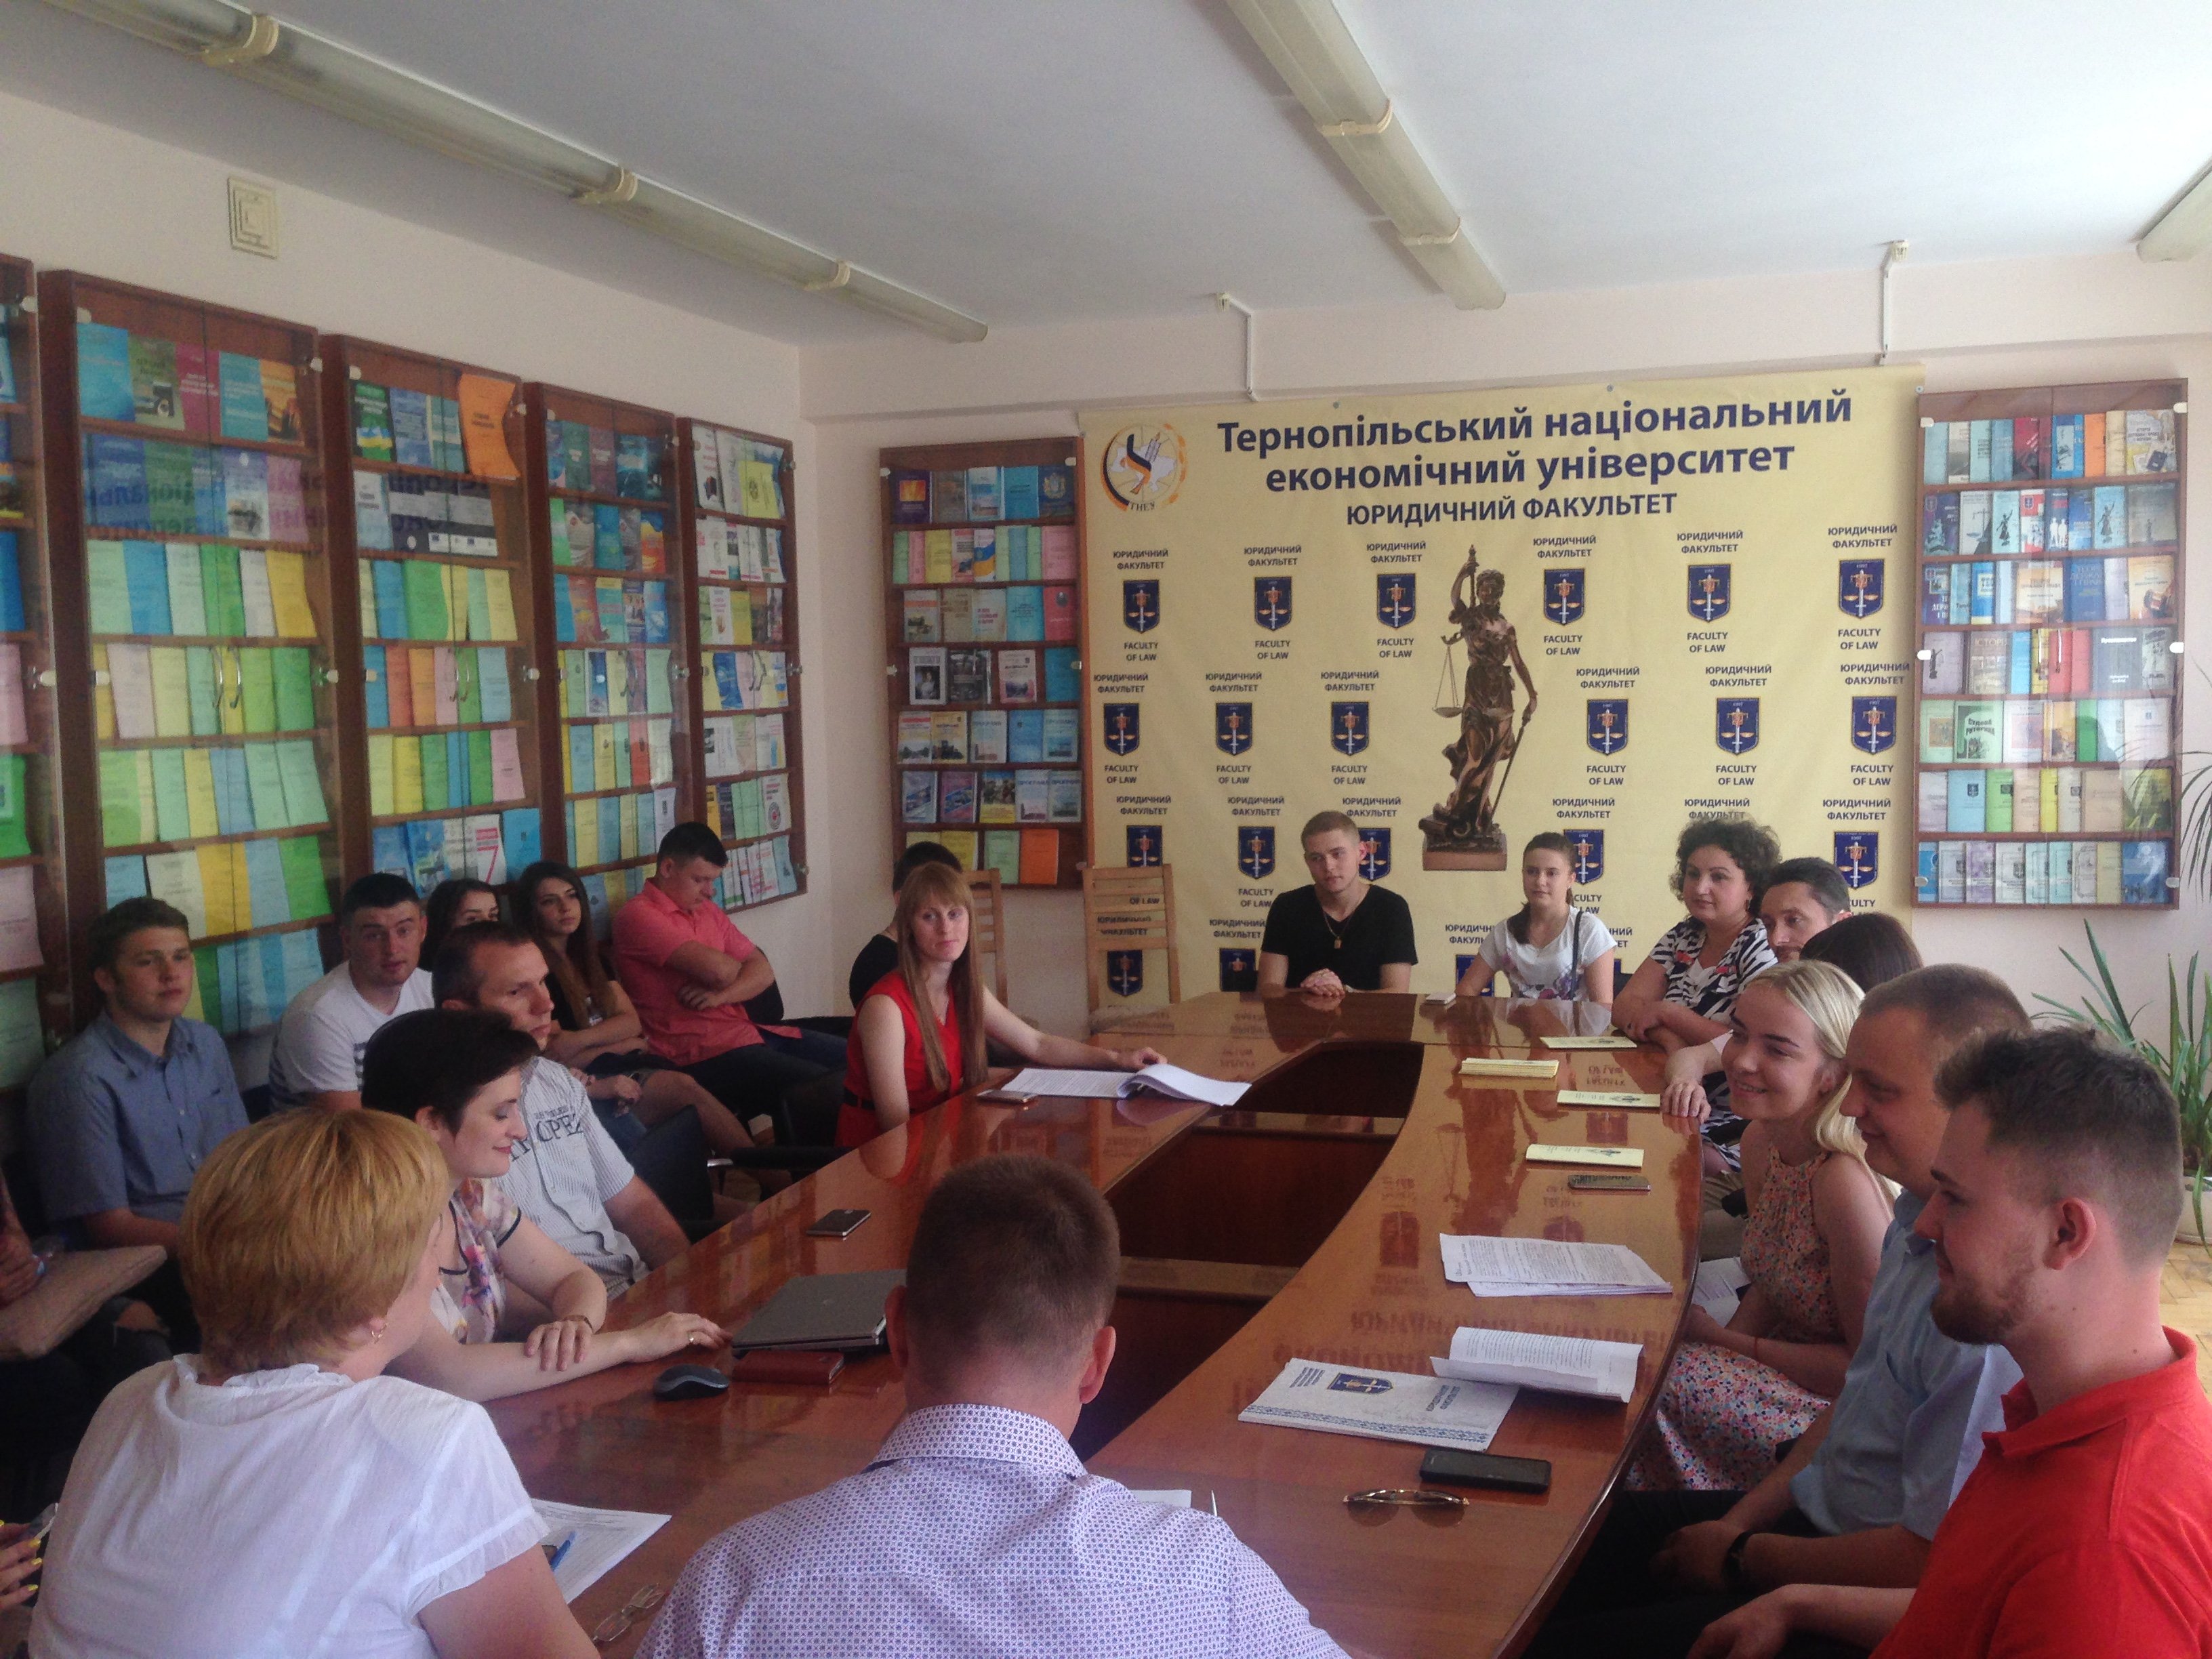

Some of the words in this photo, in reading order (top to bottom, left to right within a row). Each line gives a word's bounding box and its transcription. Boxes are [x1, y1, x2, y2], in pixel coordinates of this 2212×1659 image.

[1217, 407, 1532, 459] Тернопільський
[1545, 388, 1851, 441] національний
[1266, 451, 1524, 492] економічний
[1536, 446, 1795, 491] університет
[1347, 496, 1515, 528] ЮРИДИЧНИЙ
[1523, 493, 1677, 519] ФАКУЛЬТЕТ
[1677, 530, 1743, 541] ЮРИДИЧНИЙ
[1828, 525, 1898, 537] ЮРИДИЧНИЙ
[1533, 535, 1596, 547] ЮРИДИЧНИЙ
[1832, 538, 1893, 548] ФАКУЛЬТЕТ
[1244, 545, 1301, 556] ЮРИДИЧНИЙ
[1366, 541, 1426, 552] ЮРИДИЧНИЙ
[1681, 544, 1738, 554] ФАКУЛЬТЕТ
[1113, 549, 1168, 558] ЮРИДИЧНИЙ
[1370, 554, 1422, 563] ФАКУЛЬТЕТ
[1537, 549, 1592, 558] ФАКУЛЬТЕТ
[1117, 560, 1164, 570] ФАКУЛЬТЕТ
[1248, 558, 1298, 567] ФАКУЛЬТЕТ
[1687, 632, 1728, 642] FACULTY
[1838, 628, 1881, 637] FACULTY
[1255, 640, 1290, 648] FACULTY
[1377, 638, 1414, 648] FACULTY
[1544, 635, 1582, 643] FACULTY
[1856, 641, 1878, 649] LAW
[1576, 667, 1639, 677] ЮРИДИЧНИЙ
[1706, 665, 1771, 675] ЮРИДИЧНИЙ
[1841, 663, 1909, 674] ЮРИДИЧНИЙ
[1093, 674, 1148, 682] ЮРИДИЧНИЙ
[1206, 672, 1262, 682] ЮРИДИЧНИЙ
[1321, 670, 1379, 680] ЮРИДИЧНИЙ
[1580, 680, 1635, 689] ФАКУЛЬТЕТ
[1710, 678, 1767, 687] ФАКУЛЬТЕТ
[1845, 676, 1904, 687] ФАКУЛЬТЕТ
[1097, 684, 1145, 693] ФАКУЛЬТЕТ
[1209, 683, 1258, 692] ФАКУЛЬТЕТ
[1105, 765, 1139, 774] FACULTY
[1716, 765, 1757, 775] FACULTY
[1851, 765, 1893, 775] FACULTY
[1853, 777, 1866, 785] OF
[1869, 777, 1891, 785] LAW
[1116, 796, 1171, 804] ЮРИДИЧНИЙ
[1228, 796, 1284, 805] ЮРИДИЧНИЙ
[1343, 797, 1401, 806] ЮРИДИЧНИЙ
[1553, 798, 1615, 807] ЮРИДИЧНИЙ
[1685, 798, 1750, 808] ЮРИДИЧНИЙ
[1823, 798, 1891, 808] ЮРИДИЧНИЙ
[1827, 812, 1886, 820] ФАКУЛЬТЕТ
[1238, 888, 1273, 897] FACULTY
[1209, 918, 1266, 928] ЮРИДИЧНИЙ
[1445, 924, 1494, 934] ЮРИДИЧН
[1214, 930, 1261, 939] ФАКУЛЬТЕТ
